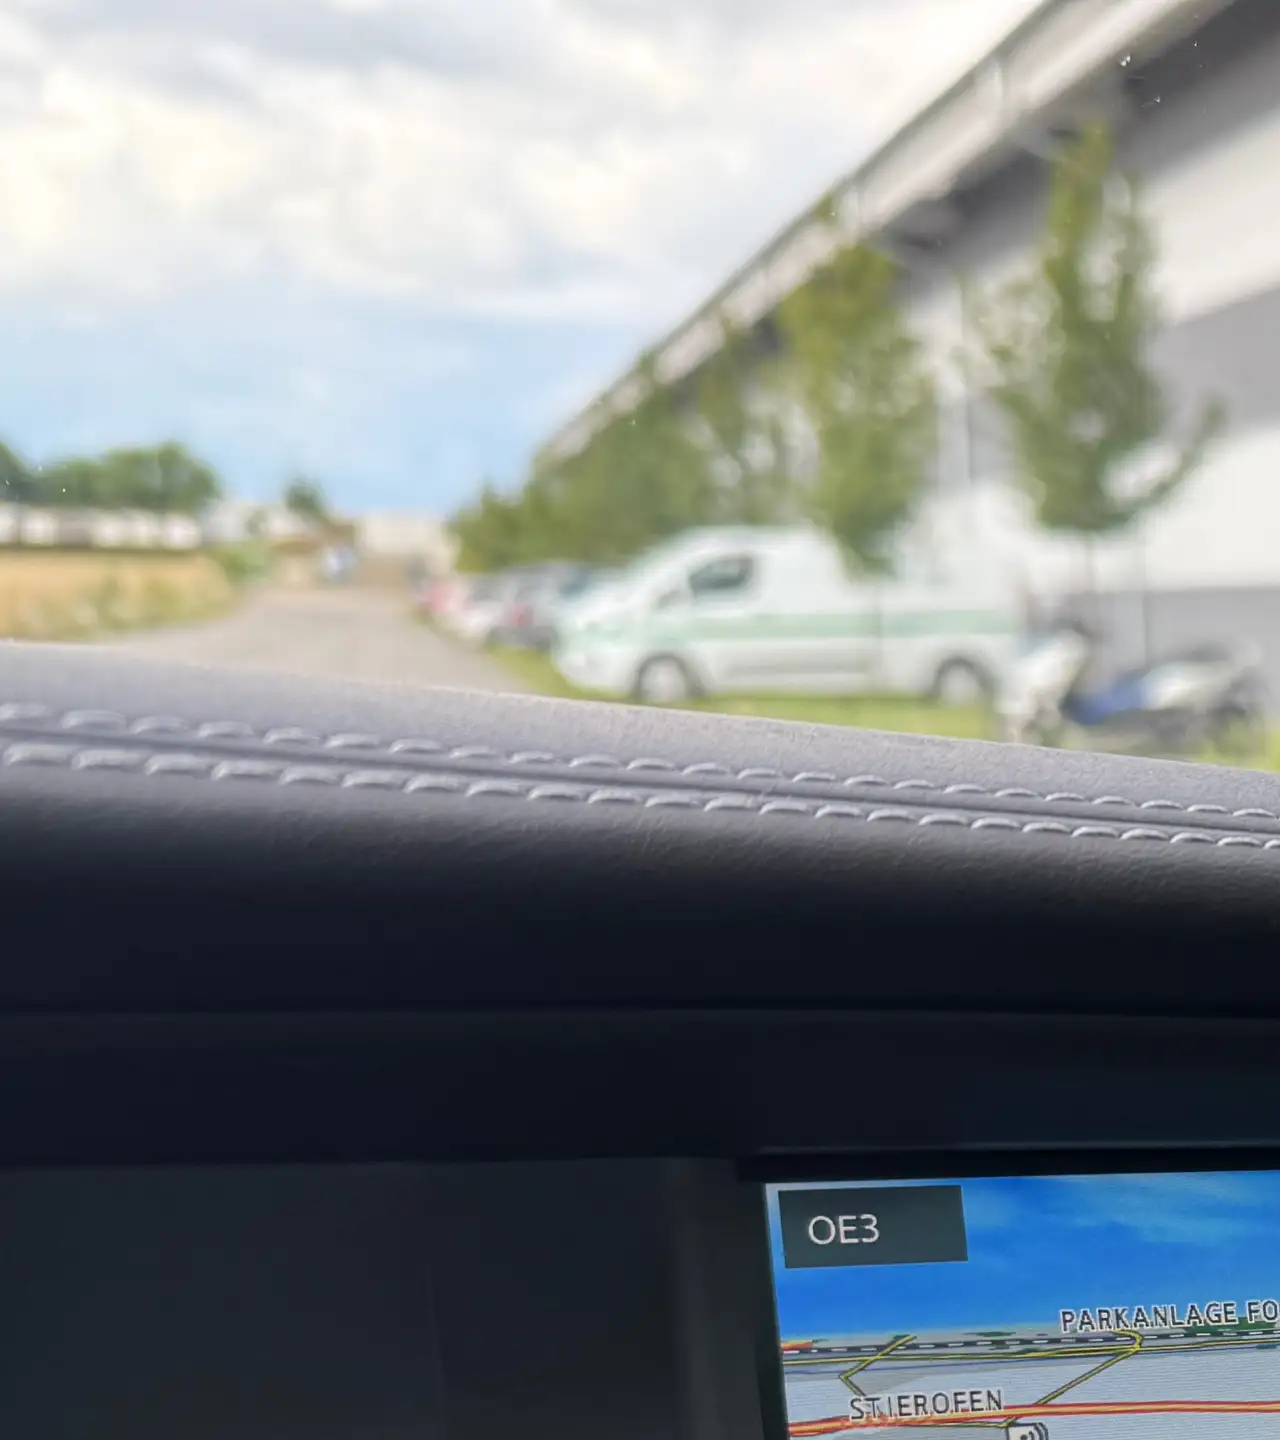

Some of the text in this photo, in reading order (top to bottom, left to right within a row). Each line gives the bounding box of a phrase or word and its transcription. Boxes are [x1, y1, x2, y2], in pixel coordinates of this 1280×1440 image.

[808, 1214, 881, 1246] OE3
[1060, 1301, 1237, 1333] PARKANLAGE
[849, 1388, 1005, 1421] STIEROFEN
